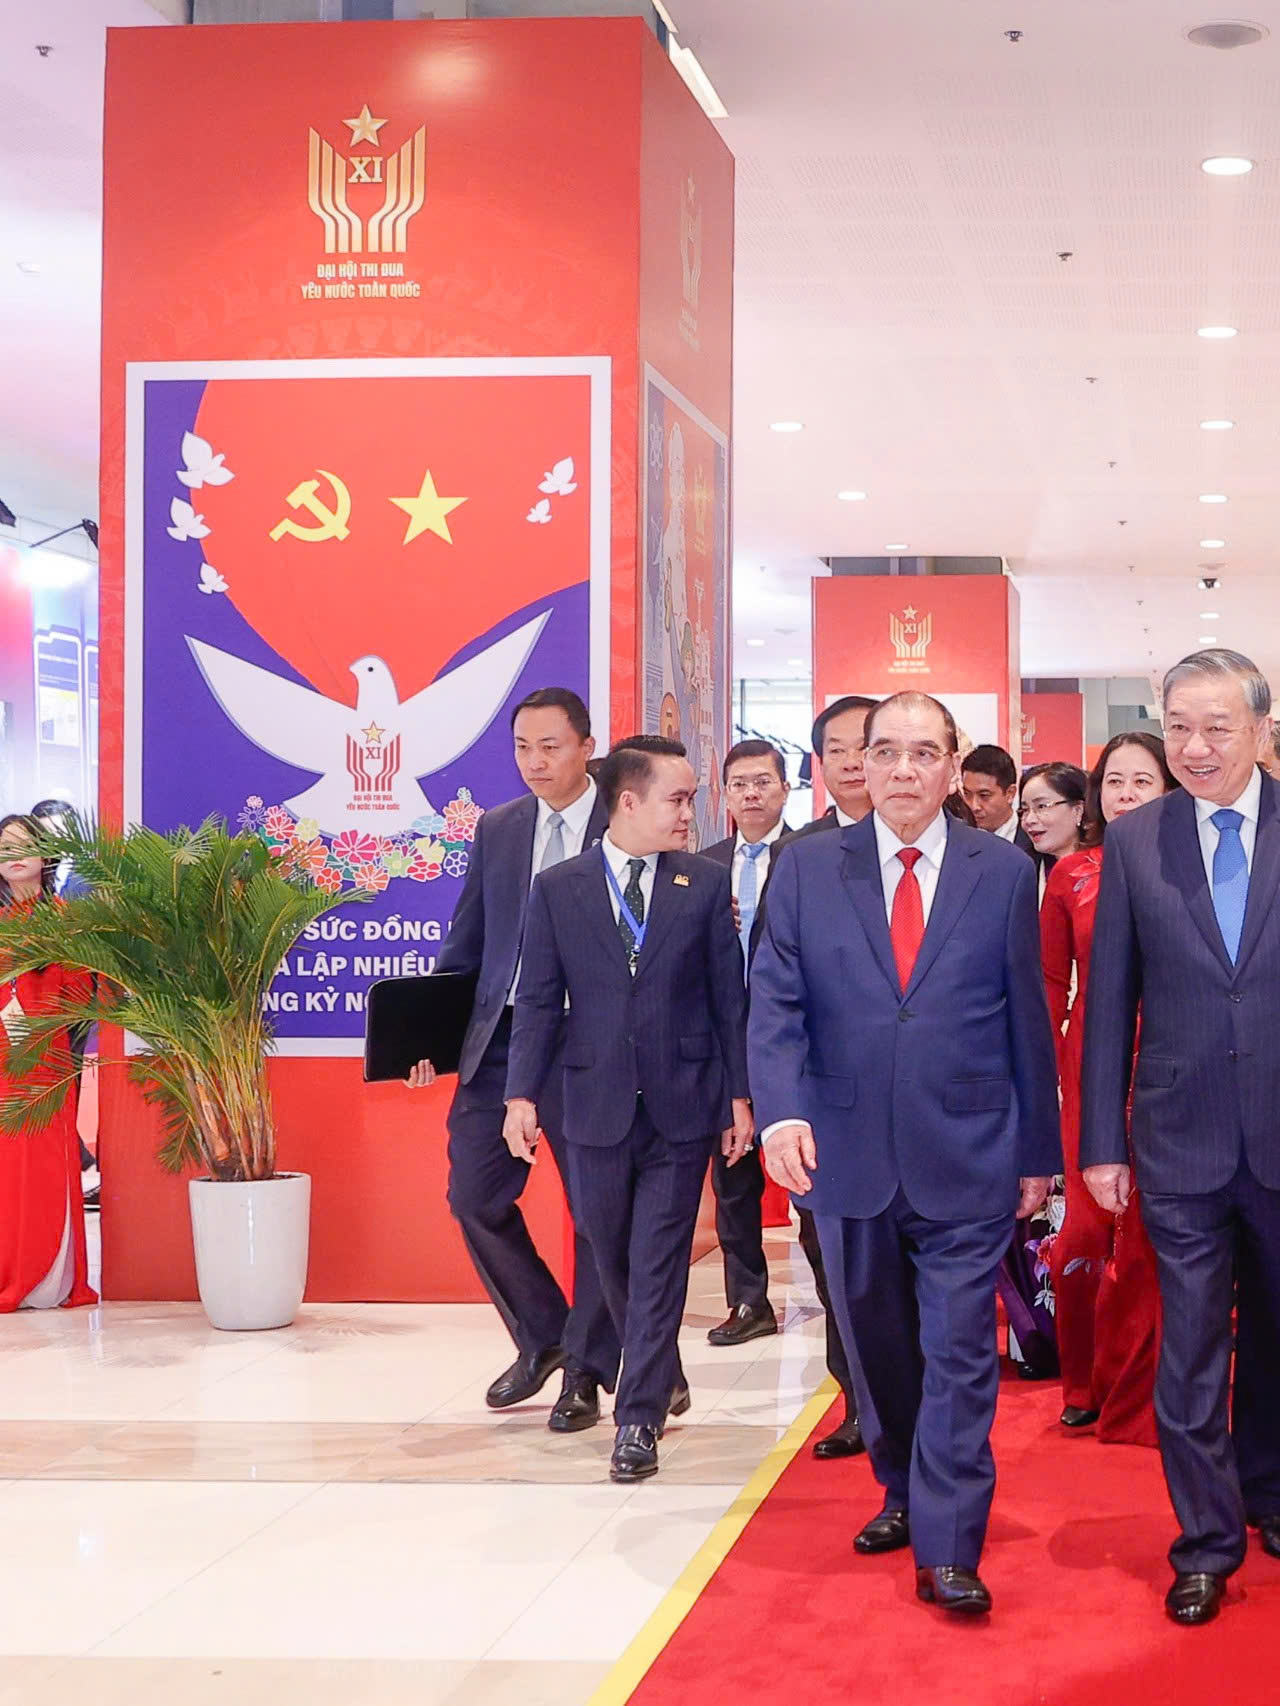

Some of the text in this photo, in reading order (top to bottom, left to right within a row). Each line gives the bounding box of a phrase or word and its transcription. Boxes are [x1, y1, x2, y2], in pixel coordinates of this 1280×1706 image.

[348, 156, 384, 183] XI
[317, 260, 404, 281] ĐẠI HỘI THI ĐUA
[301, 280, 322, 300] YÊU
[390, 280, 421, 299] QUỐC
[365, 746, 381, 759] XI
[303, 915, 358, 942] SỨC
[362, 913, 442, 942] ĐỒNG
[296, 951, 348, 983] LẬP
[353, 949, 436, 977] NHIỀU
[305, 985, 340, 1013] KỶ
